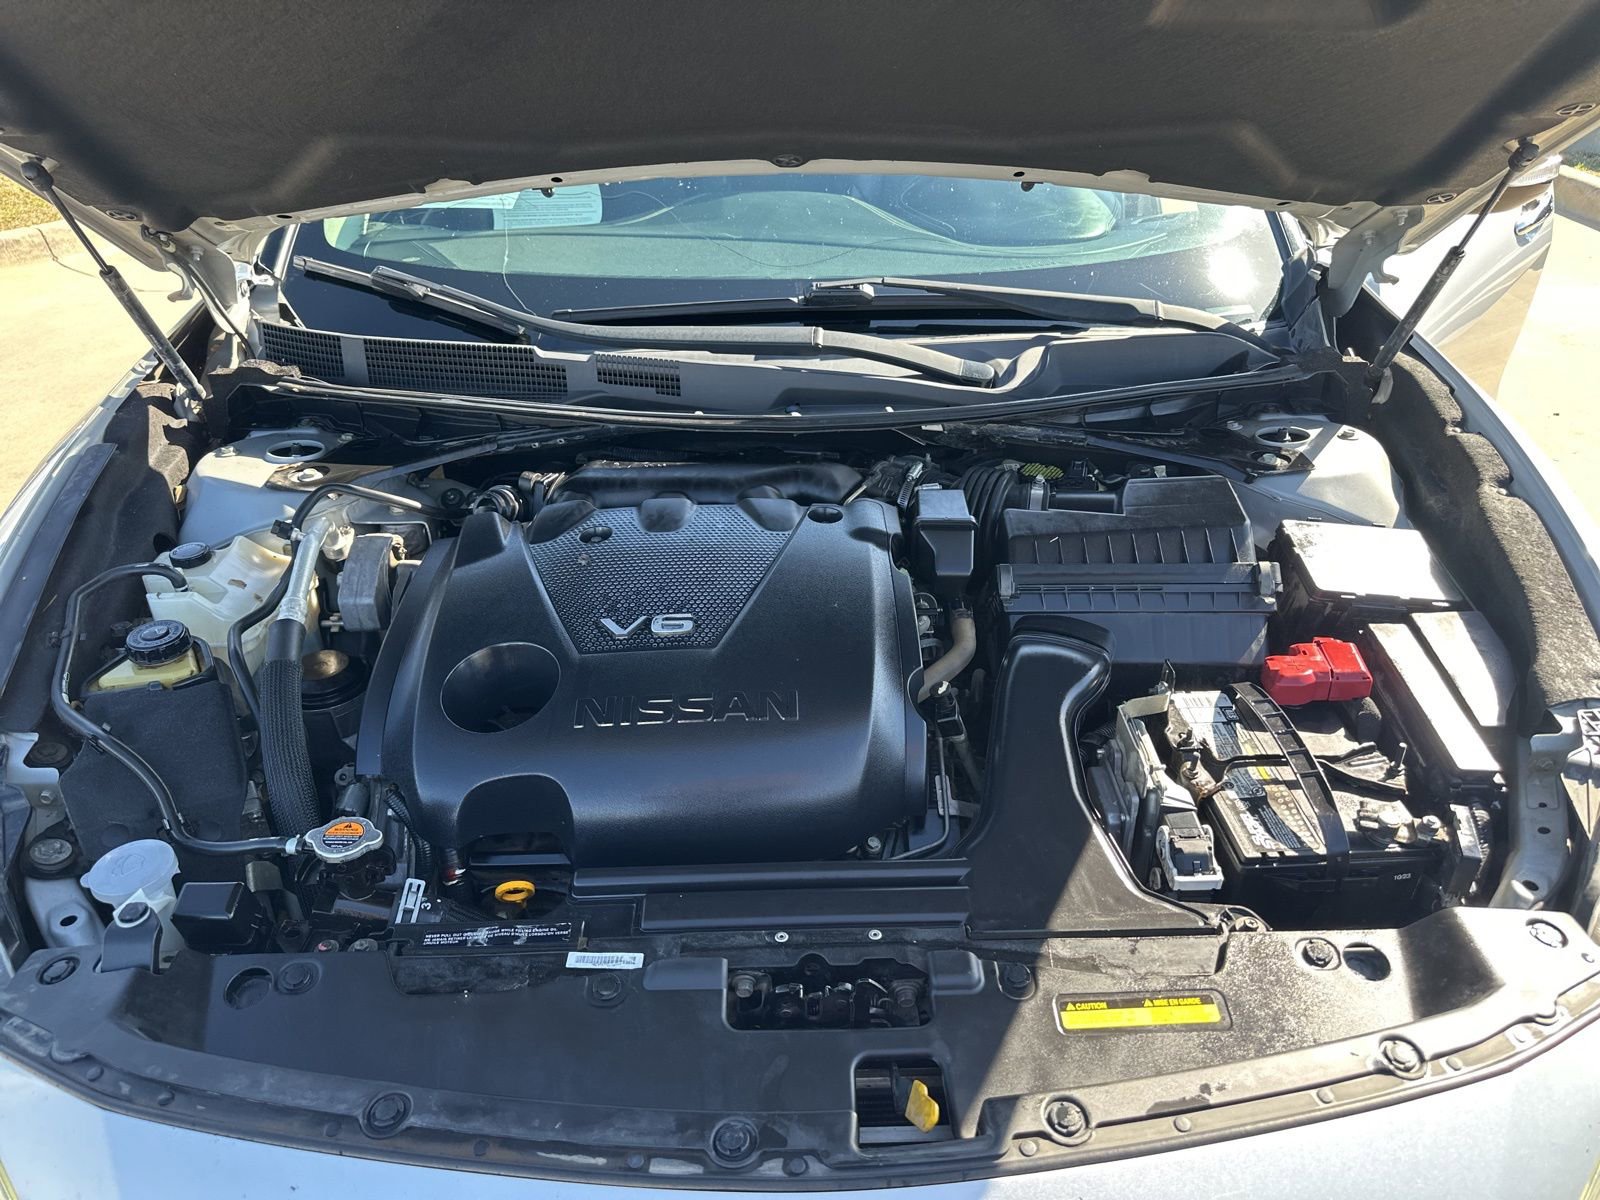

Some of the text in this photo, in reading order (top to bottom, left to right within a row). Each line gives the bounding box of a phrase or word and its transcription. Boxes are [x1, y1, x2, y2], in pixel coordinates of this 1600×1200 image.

[600, 613, 695, 639] V6
[573, 689, 799, 729] NISSAN
[421, 902, 432, 911] 3
[1075, 1001, 1107, 1011] CAUTION
[1178, 997, 1202, 1005] GARDE
